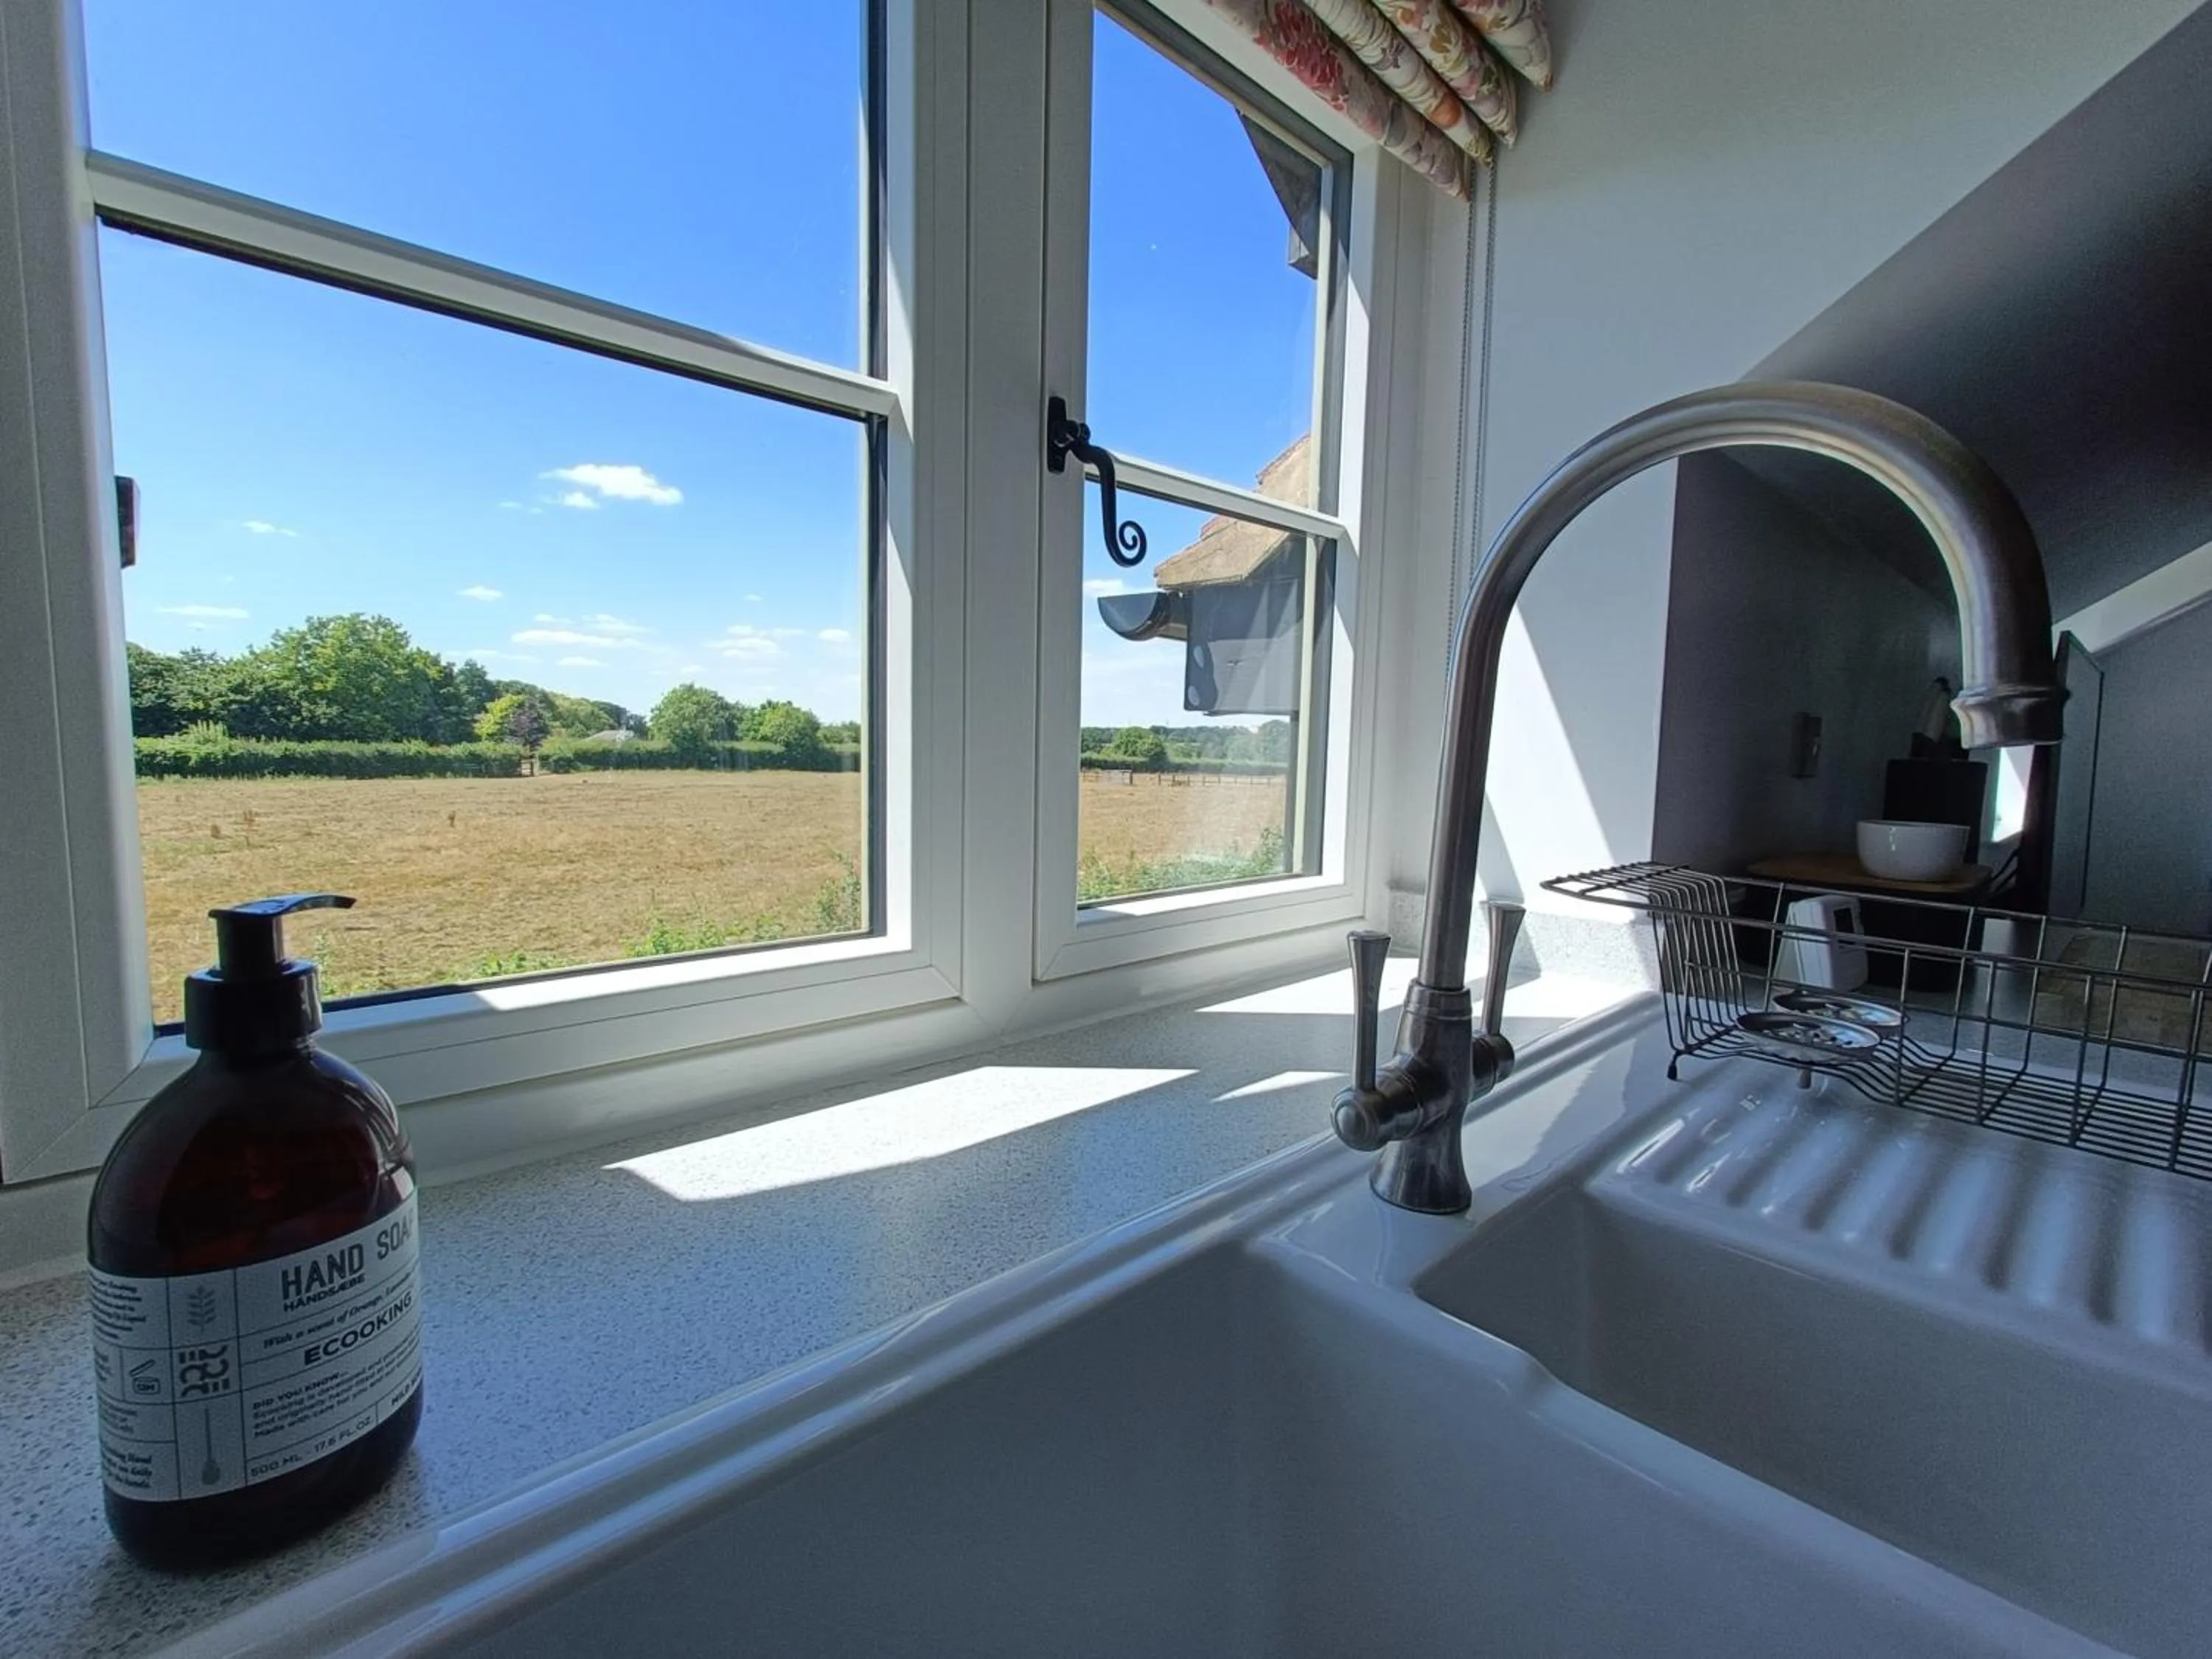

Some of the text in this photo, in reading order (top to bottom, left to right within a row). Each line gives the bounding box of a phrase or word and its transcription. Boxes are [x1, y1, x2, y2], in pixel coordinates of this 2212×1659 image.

[282, 1243, 364, 1301] HAND
[304, 1292, 412, 1365] ECOOKING
[253, 1398, 274, 1410] DID
[278, 1388, 302, 1399] YOU
[251, 1461, 279, 1477] 500
[282, 1454, 303, 1467] ML
